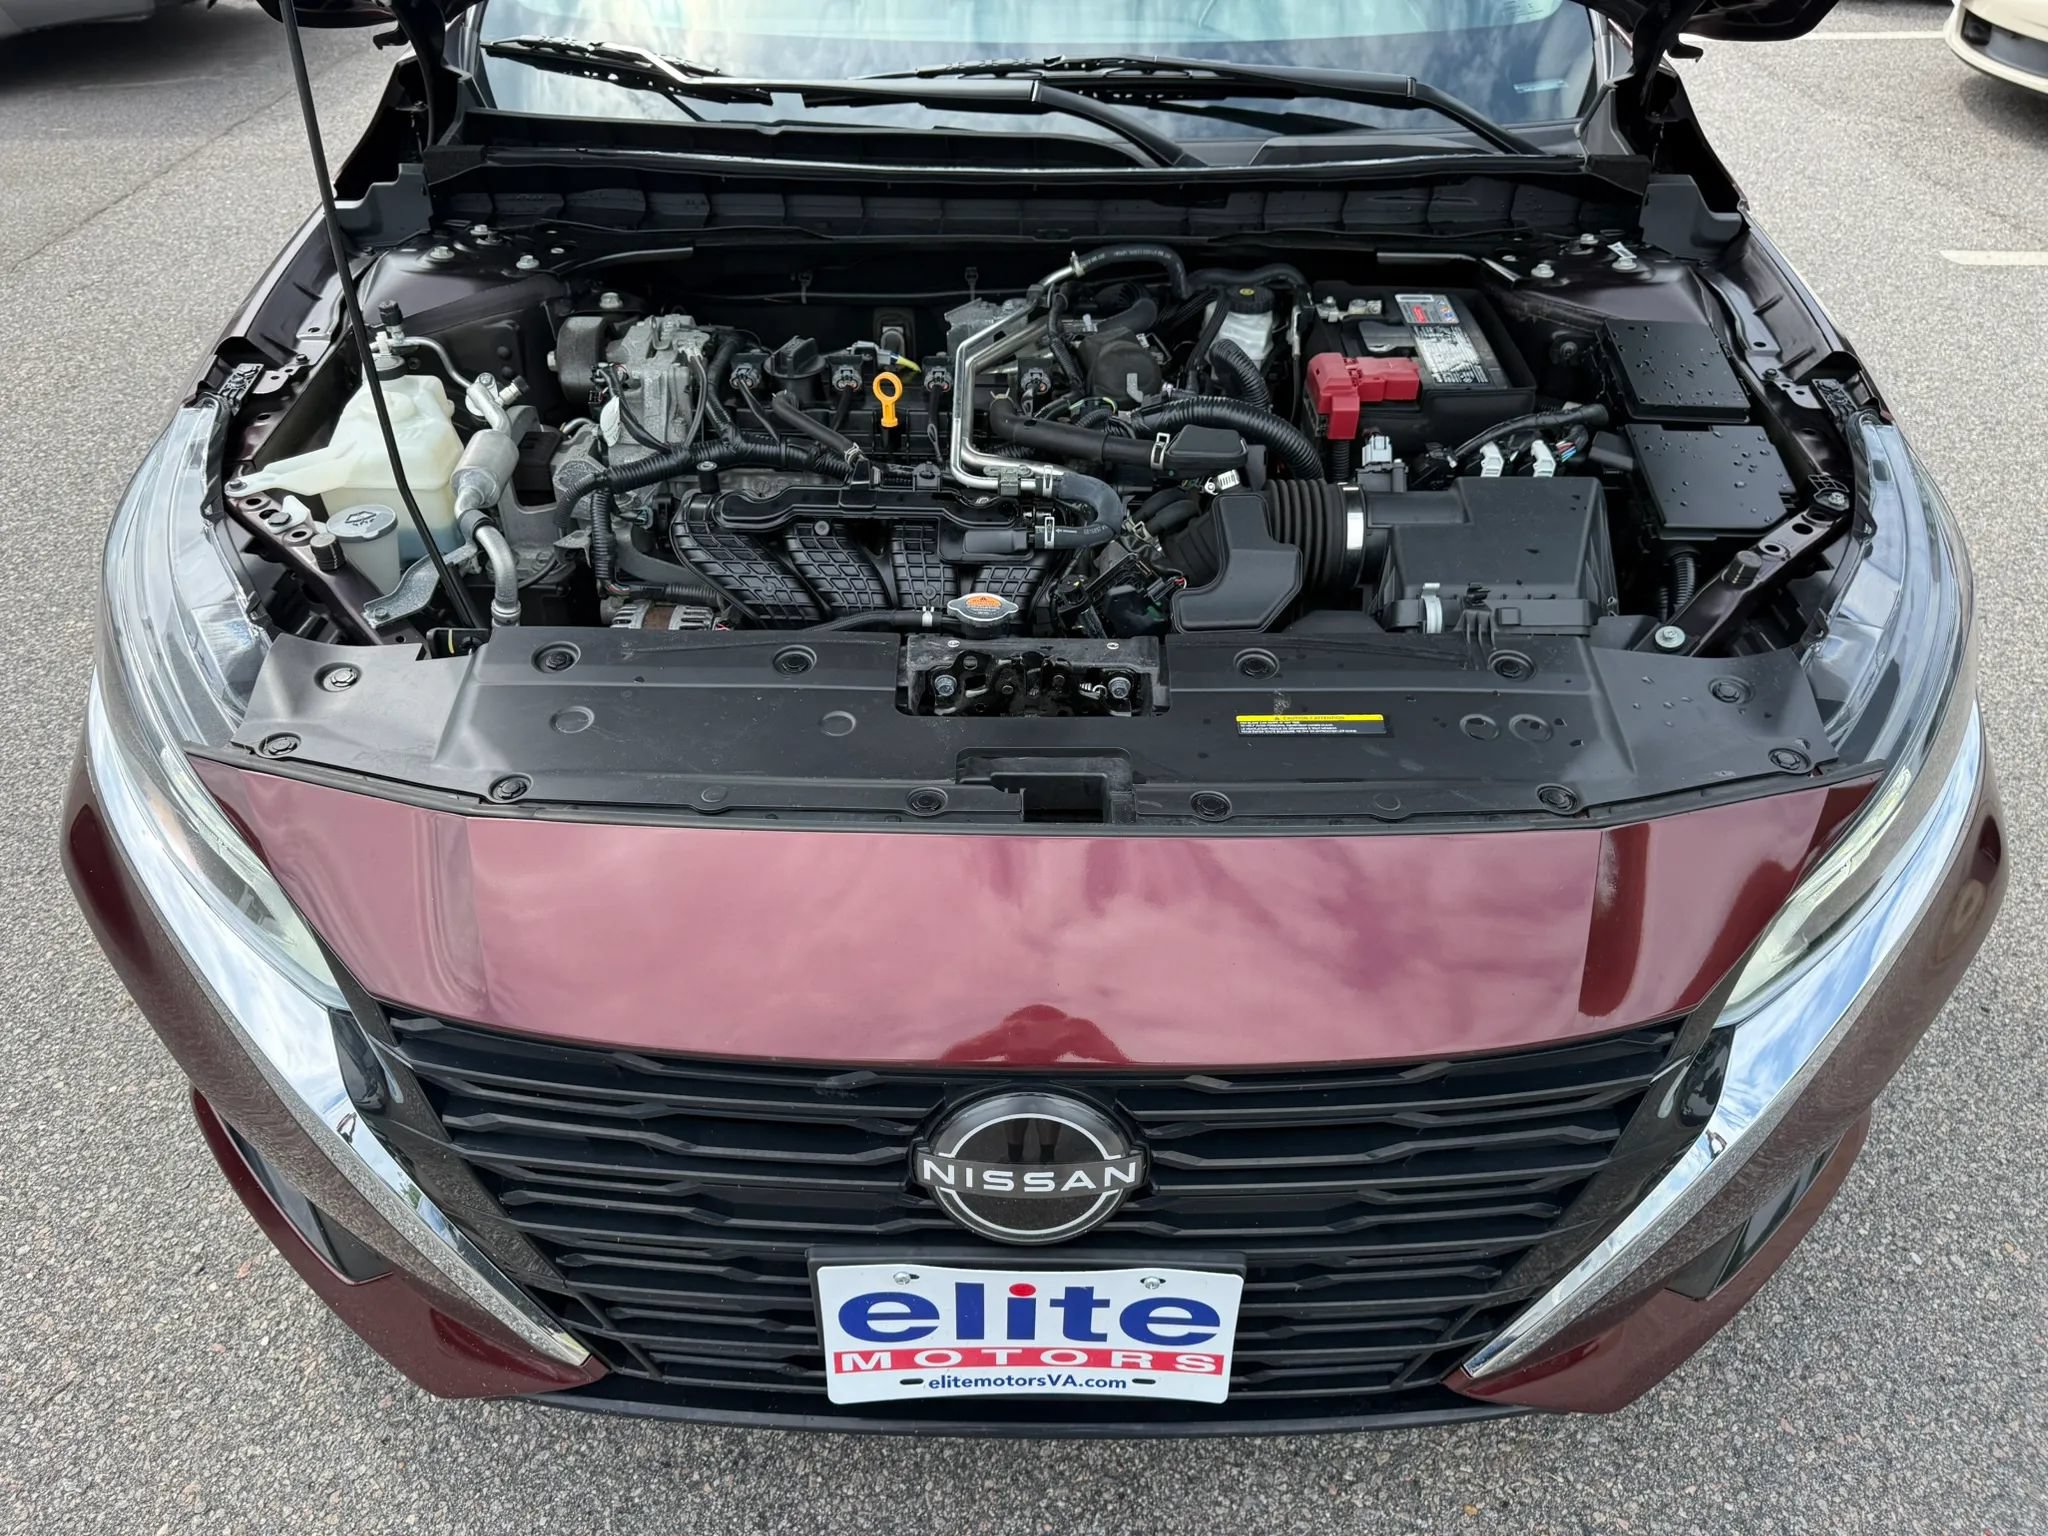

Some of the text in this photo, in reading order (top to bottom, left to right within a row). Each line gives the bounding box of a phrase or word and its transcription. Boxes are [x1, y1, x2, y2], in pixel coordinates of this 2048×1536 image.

[923, 1159, 1136, 1193] NISSAN
[838, 1282, 1221, 1346] elite
[841, 1348, 1217, 1373] MOTORS
[928, 1373, 1127, 1390] elitemotorsVA.com
